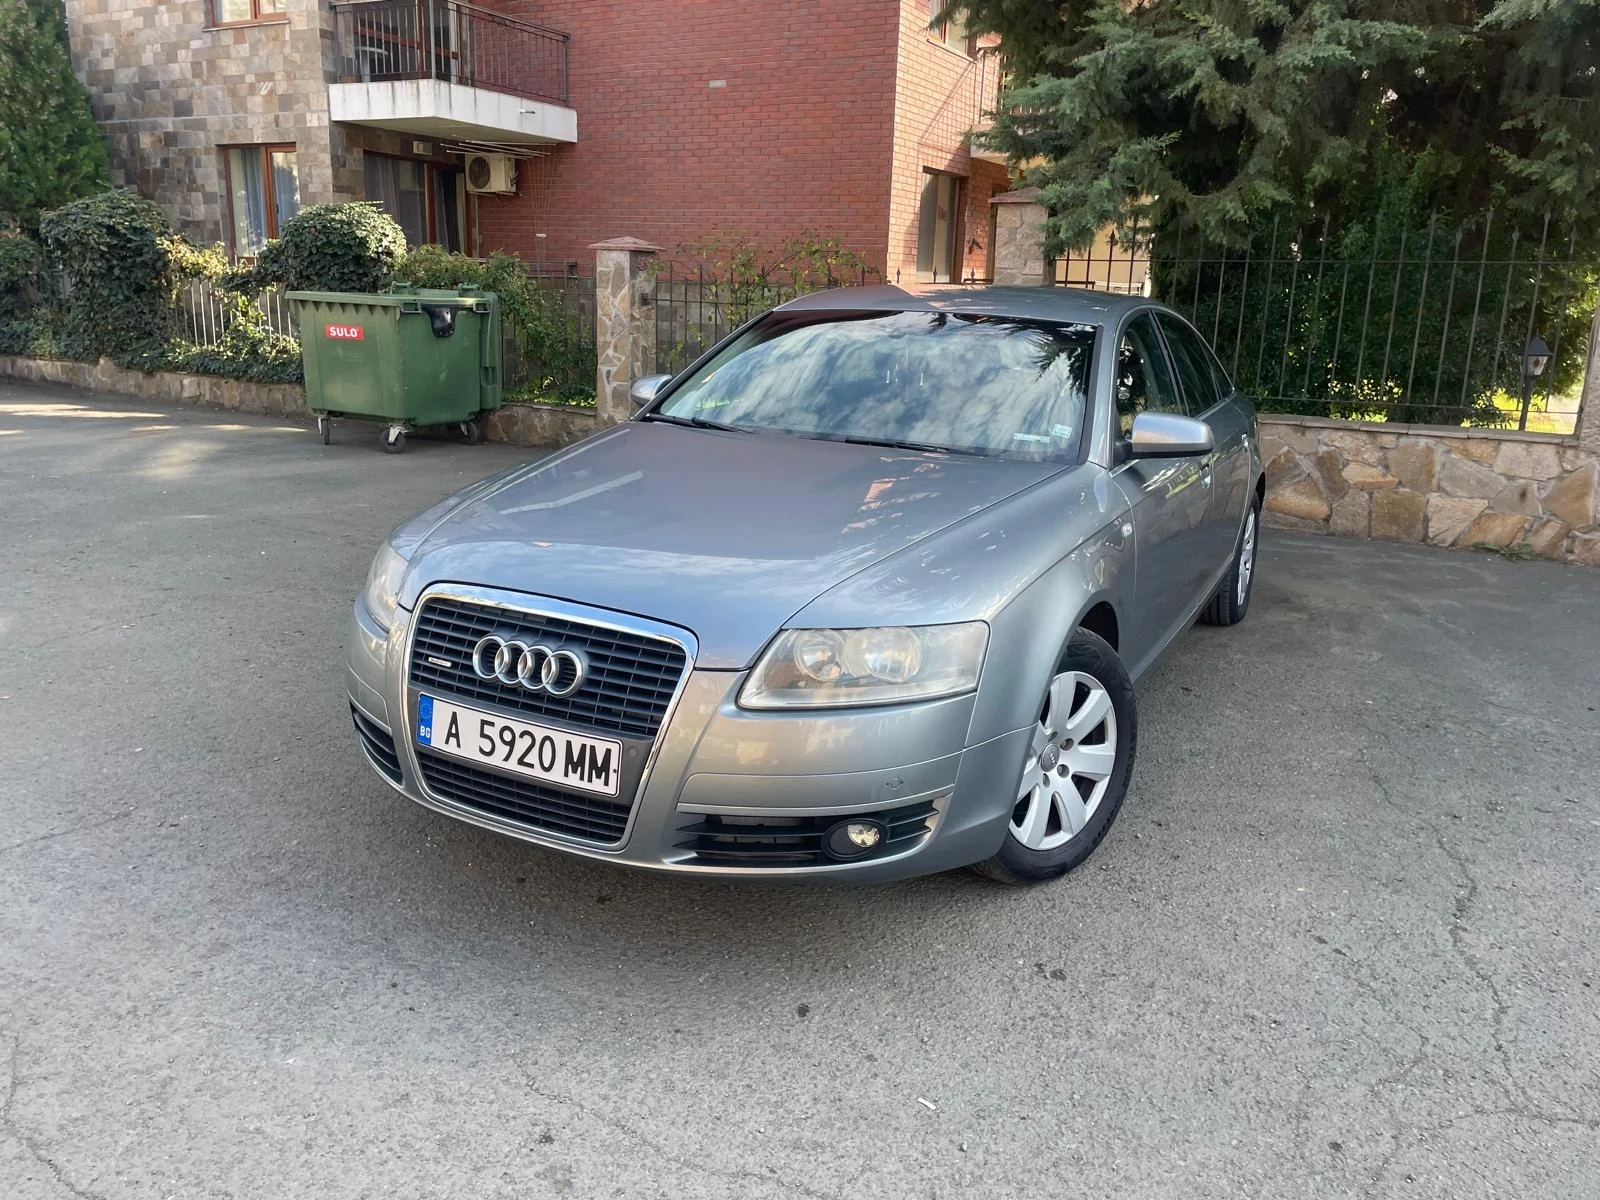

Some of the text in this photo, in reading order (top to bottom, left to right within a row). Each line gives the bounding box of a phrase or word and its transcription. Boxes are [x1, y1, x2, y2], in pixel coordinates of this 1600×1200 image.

[329, 326, 358, 338] SULO
[420, 725, 431, 739] BG
[444, 711, 612, 787] A 5920 MM
